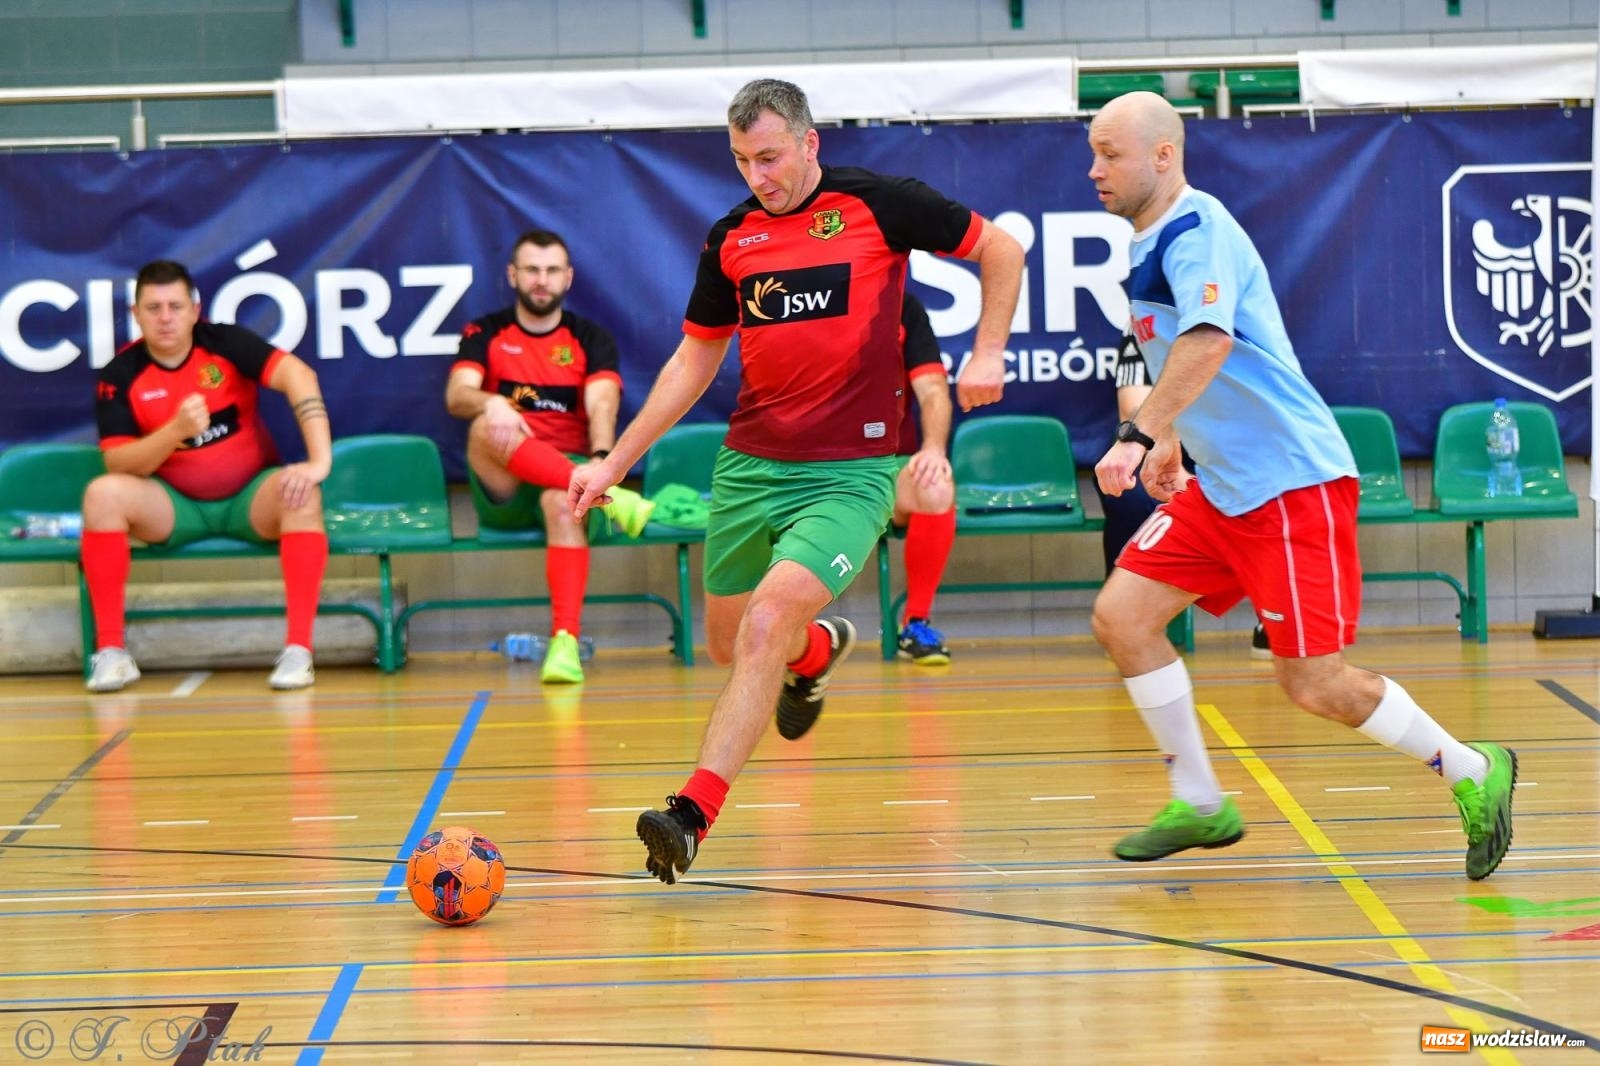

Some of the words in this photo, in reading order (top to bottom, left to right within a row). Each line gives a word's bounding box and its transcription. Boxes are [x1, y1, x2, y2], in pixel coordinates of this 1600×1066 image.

[0, 238, 473, 373] CIÓRZ
[781, 290, 832, 318] JSW
[1131, 510, 1173, 551] 10
